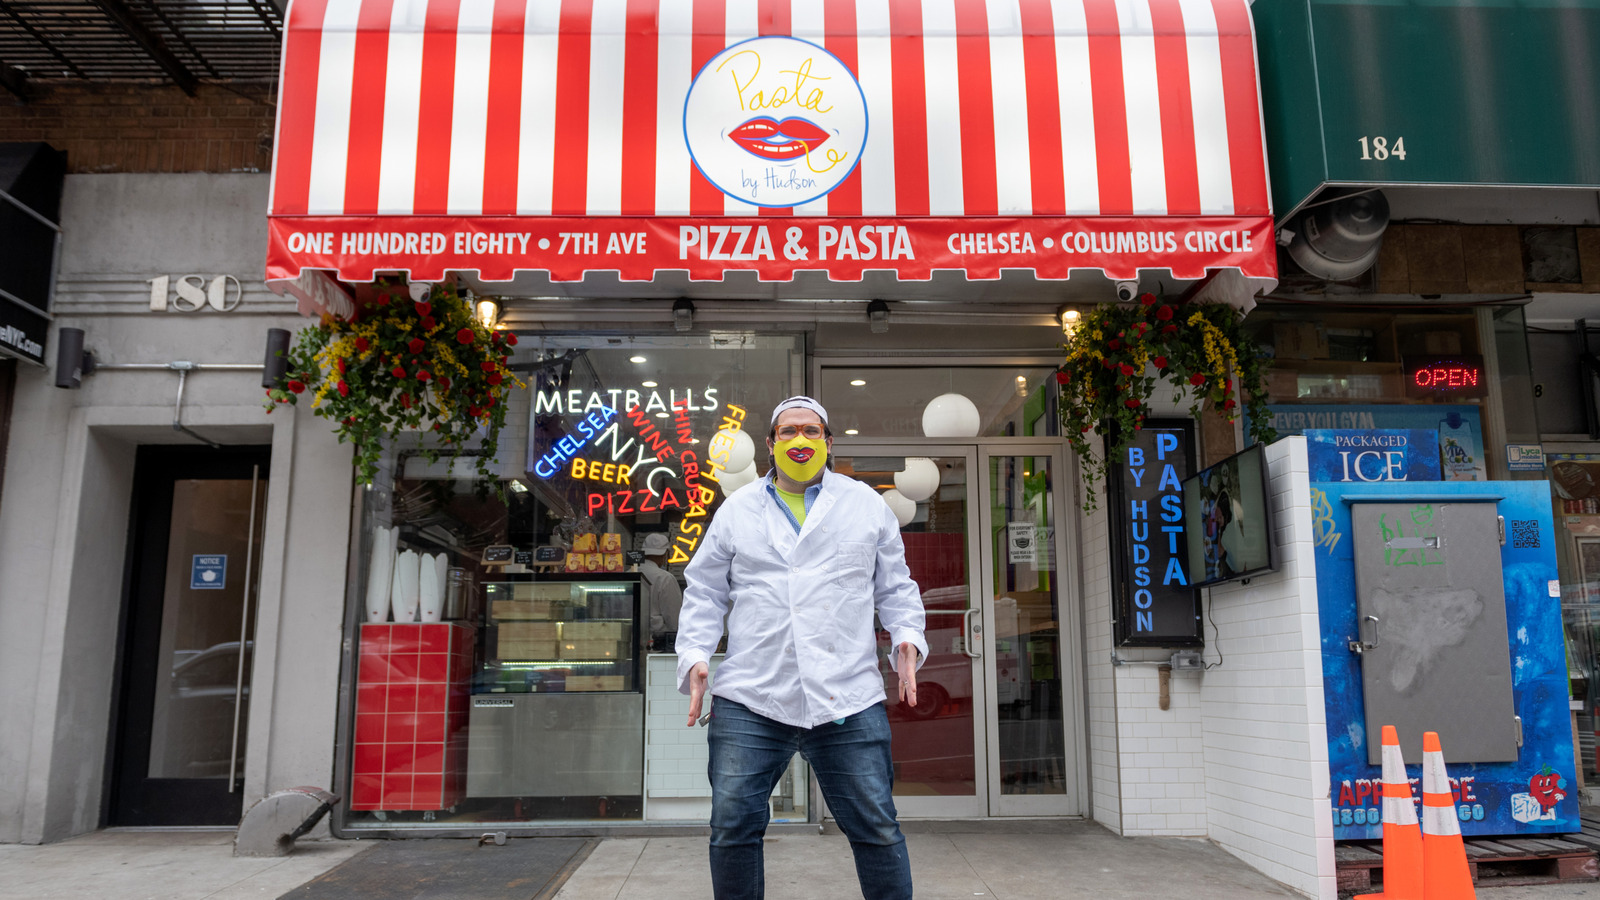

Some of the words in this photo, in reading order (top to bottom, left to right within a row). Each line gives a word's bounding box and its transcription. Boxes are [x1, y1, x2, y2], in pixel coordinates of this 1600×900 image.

[716, 50, 833, 113] Pasta
[1358, 136, 1407, 161] 184
[741, 168, 759, 198] by
[764, 167, 816, 190] Hudson
[288, 232, 333, 254] ONE
[341, 232, 446, 254] HUNDRED
[454, 232, 532, 254] EIGHTY
[558, 232, 598, 254] 7TH
[606, 232, 646, 254] AVE
[679, 225, 776, 260] PIZZA
[783, 226, 809, 260] &
[818, 225, 915, 260] PASTA
[947, 232, 1036, 254] CHELSEA
[1061, 231, 1178, 254] COLUMBUS
[1184, 230, 1253, 253] CIRCLE
[146, 274, 241, 312] 180
[1415, 368, 1478, 386] OPEN
[534, 387, 719, 414] MEATBALLS
[626, 404, 675, 463] WINE
[673, 397, 693, 444] THIN
[1307, 412, 1337, 429] YOU
[1341, 412, 1375, 429] GYM
[534, 404, 619, 479] CHELSEA
[700, 403, 746, 483] FRESH
[1336, 435, 1407, 447] PACKAGED
[1444, 445, 1468, 457] VITA
[1520, 447, 1541, 456] Lyca
[571, 457, 631, 486] BEER
[594, 422, 676, 498] NYC
[1128, 447, 1146, 488] BY
[1339, 451, 1408, 482] ICE
[680, 449, 705, 508] CRUST
[587, 486, 681, 517] PIZZA
[1156, 433, 1188, 586] PASTA
[666, 485, 715, 564] PASTA
[199, 557, 220, 565] NOTICE
[1131, 500, 1153, 632] HUDSON
[1338, 778, 1421, 806] APPE
